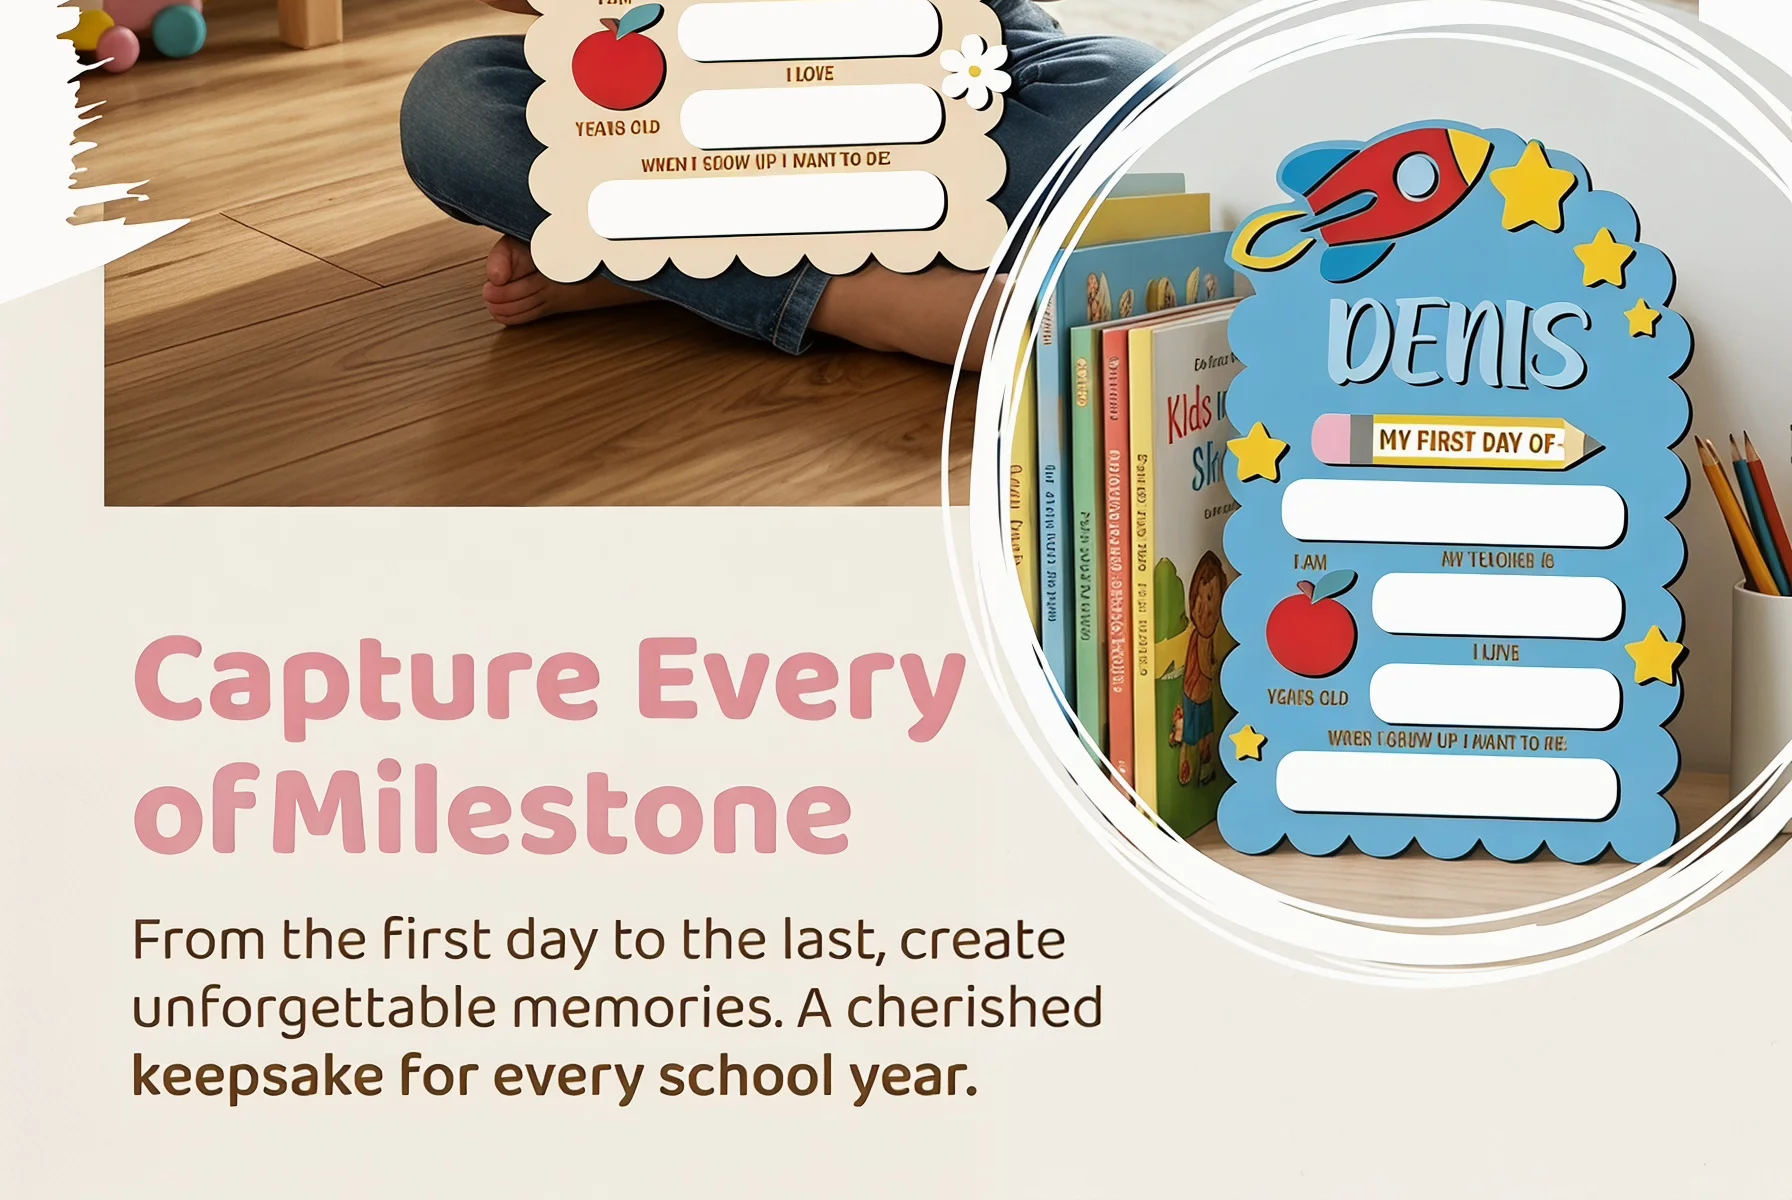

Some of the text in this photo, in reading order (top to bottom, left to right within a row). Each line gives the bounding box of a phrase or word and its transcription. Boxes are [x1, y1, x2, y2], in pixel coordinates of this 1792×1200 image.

[786, 65, 834, 82] I LOVE
[691, 156, 697, 171] I
[782, 153, 787, 168] I
[839, 152, 861, 167] TO
[1328, 296, 1592, 390] DENIS
[1380, 429, 1411, 451] MY
[1417, 430, 1476, 452] FIRST
[1483, 431, 1523, 453] DAY
[1473, 643, 1478, 660] I
[1437, 732, 1458, 749] UP
[1463, 733, 1468, 749] I
[1520, 735, 1540, 751] TO
